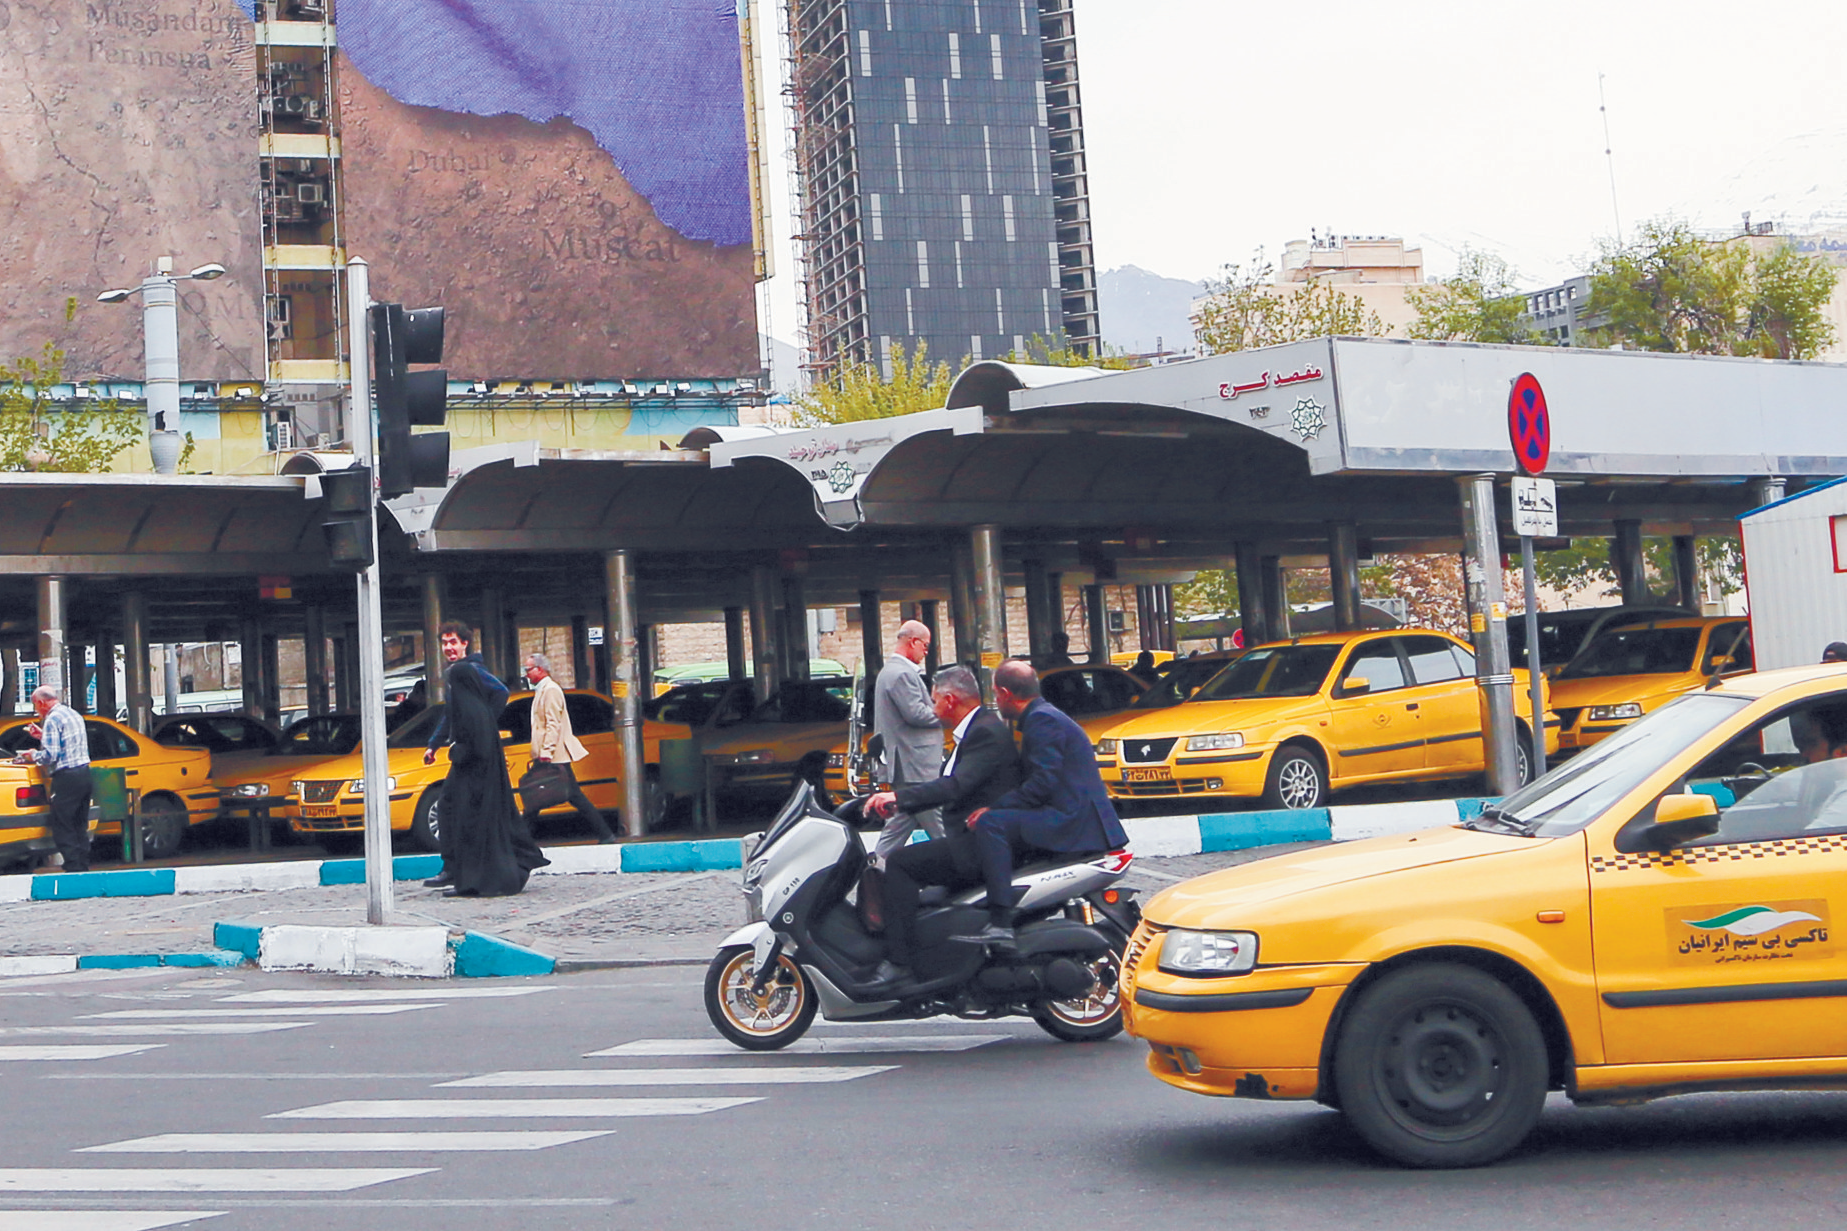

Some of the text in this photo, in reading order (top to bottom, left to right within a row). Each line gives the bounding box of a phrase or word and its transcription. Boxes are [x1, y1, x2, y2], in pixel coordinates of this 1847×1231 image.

[407, 150, 491, 173] Dubai
[537, 227, 681, 263] Muscat
[1219, 363, 1322, 398] مقصد کرج
[1678, 928, 1829, 954] تاکسی بی سیم ایرانیان
